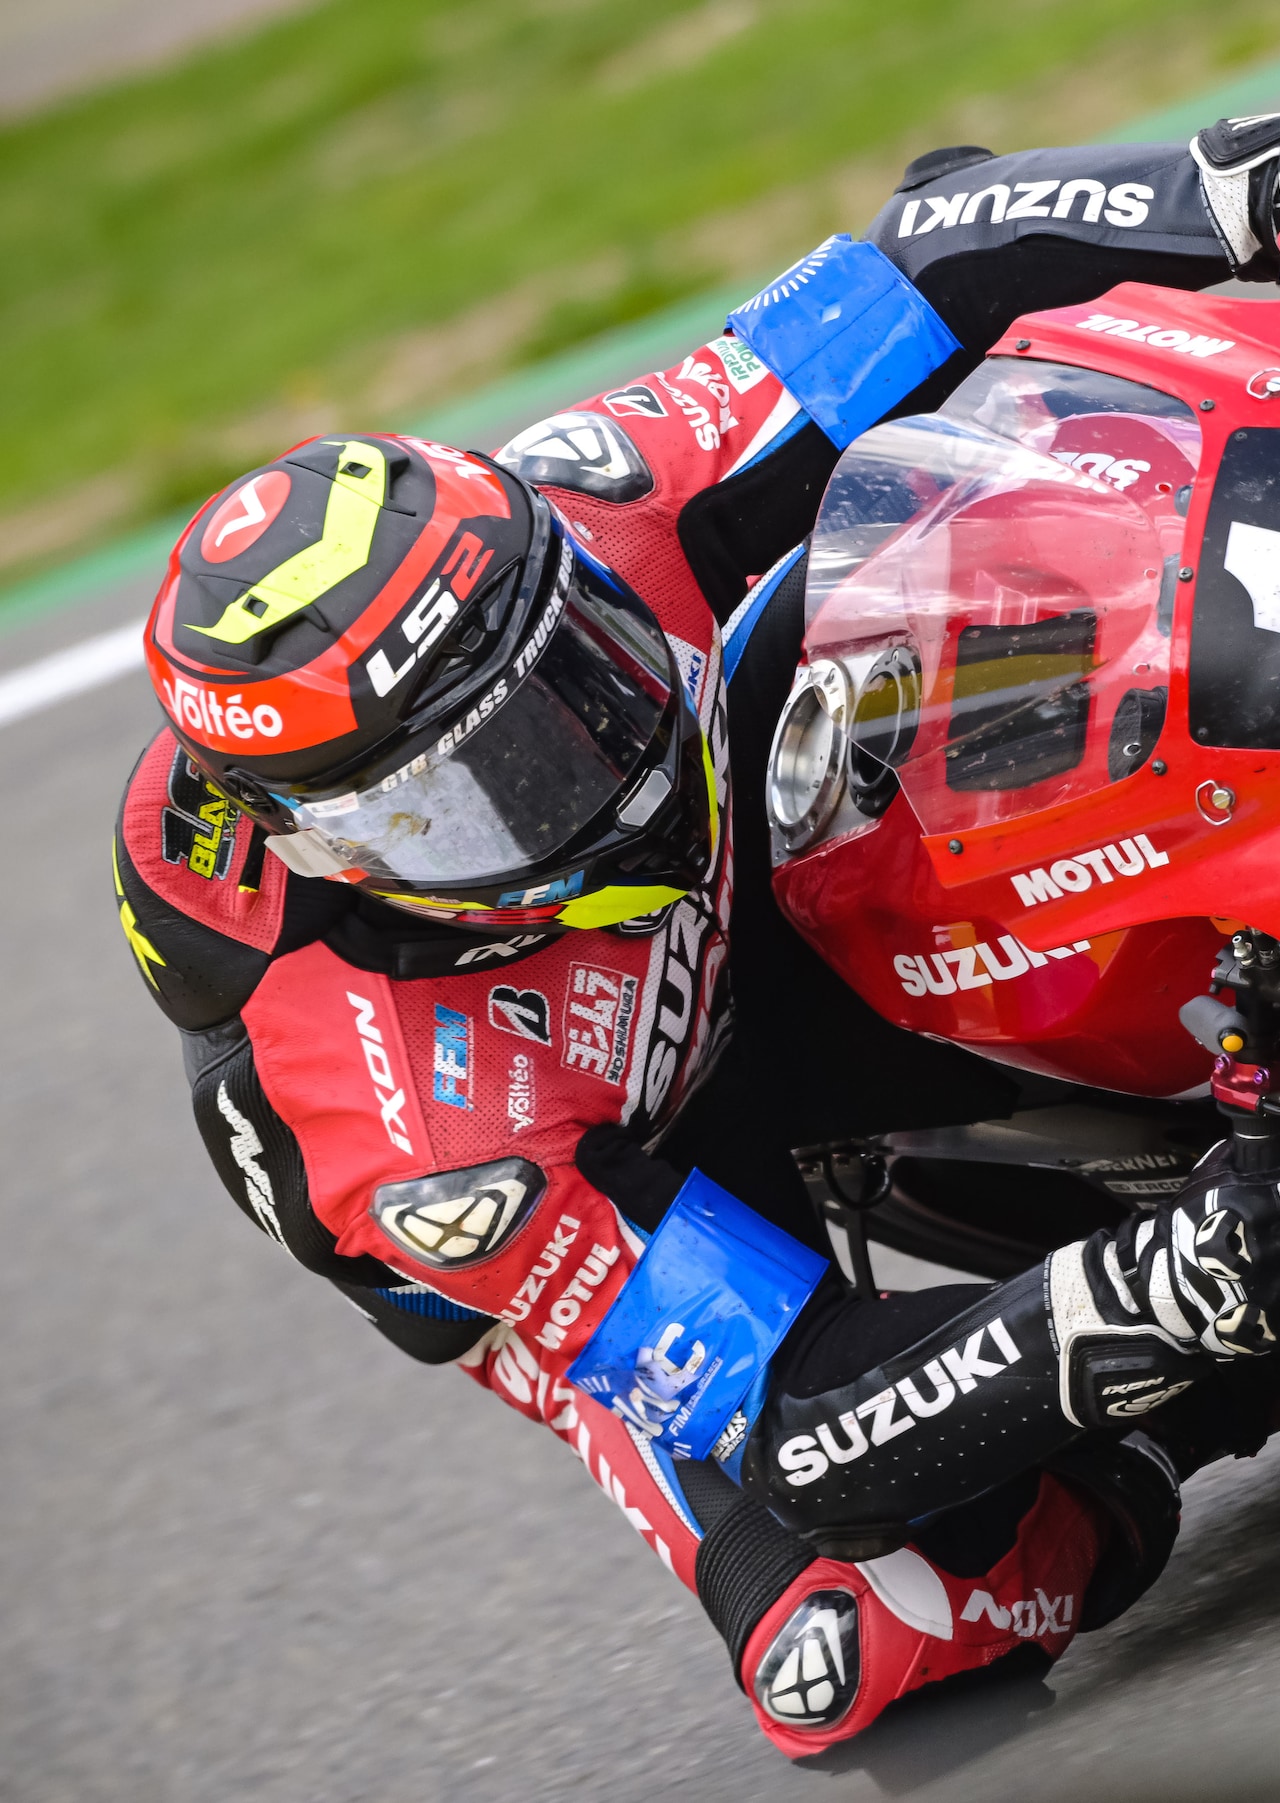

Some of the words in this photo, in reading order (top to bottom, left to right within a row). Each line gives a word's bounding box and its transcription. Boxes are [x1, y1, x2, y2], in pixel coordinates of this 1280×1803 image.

[898, 179, 1154, 238] SUZUKI
[1076, 315, 1235, 357] MOTUL
[366, 531, 495, 697] LS2
[381, 753, 428, 793] GTB
[437, 678, 508, 756] GLASS
[513, 591, 563, 678] TRUCK
[558, 537, 574, 591] BUS
[163, 678, 283, 739] Voltéo
[496, 869, 585, 908] FFM
[1010, 834, 1169, 907] MOTUL
[346, 991, 414, 1156] IXON
[433, 1002, 468, 1110] FFM
[608, 979, 637, 1083] YOSHIMURA
[508, 1053, 535, 1133] Voltéo
[534, 1242, 621, 1350] MOTUL
[777, 1317, 1023, 1487] SUZUKI
